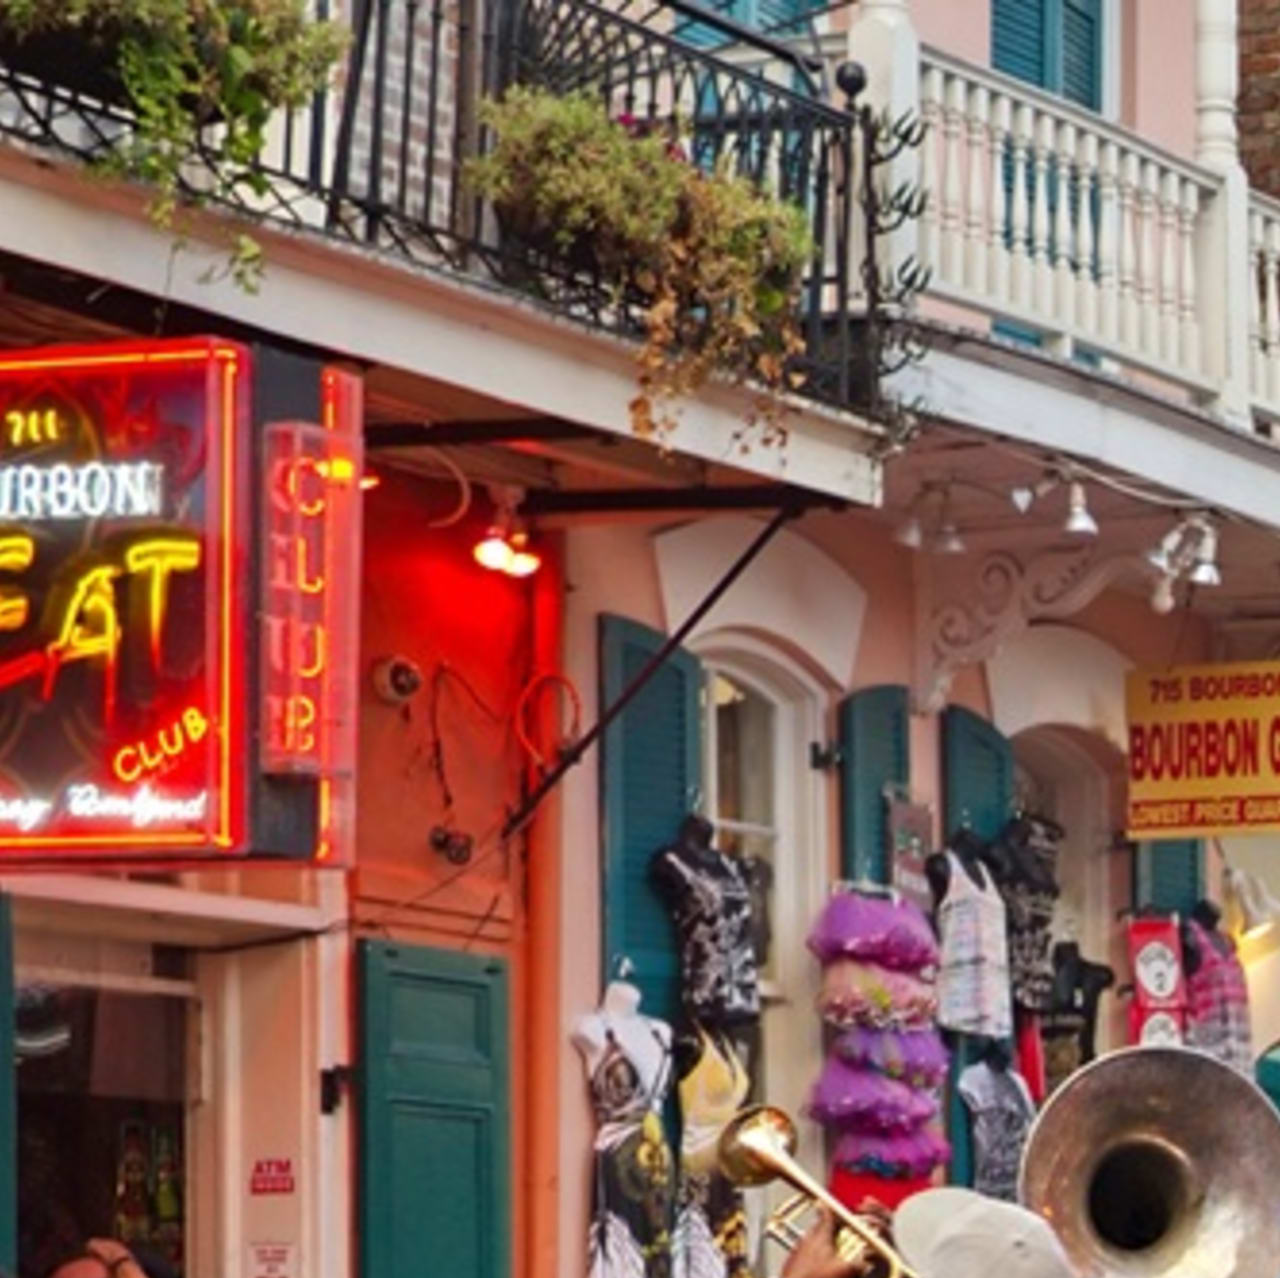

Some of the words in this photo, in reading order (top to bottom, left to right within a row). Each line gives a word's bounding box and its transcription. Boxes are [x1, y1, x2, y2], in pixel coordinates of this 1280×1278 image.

[6, 410, 58, 446] 711
[270, 456, 326, 752] CLUB
[113, 707, 208, 783] CLUB
[1130, 715, 1260, 782] BOURBON
[254, 1158, 291, 1175] ATM
